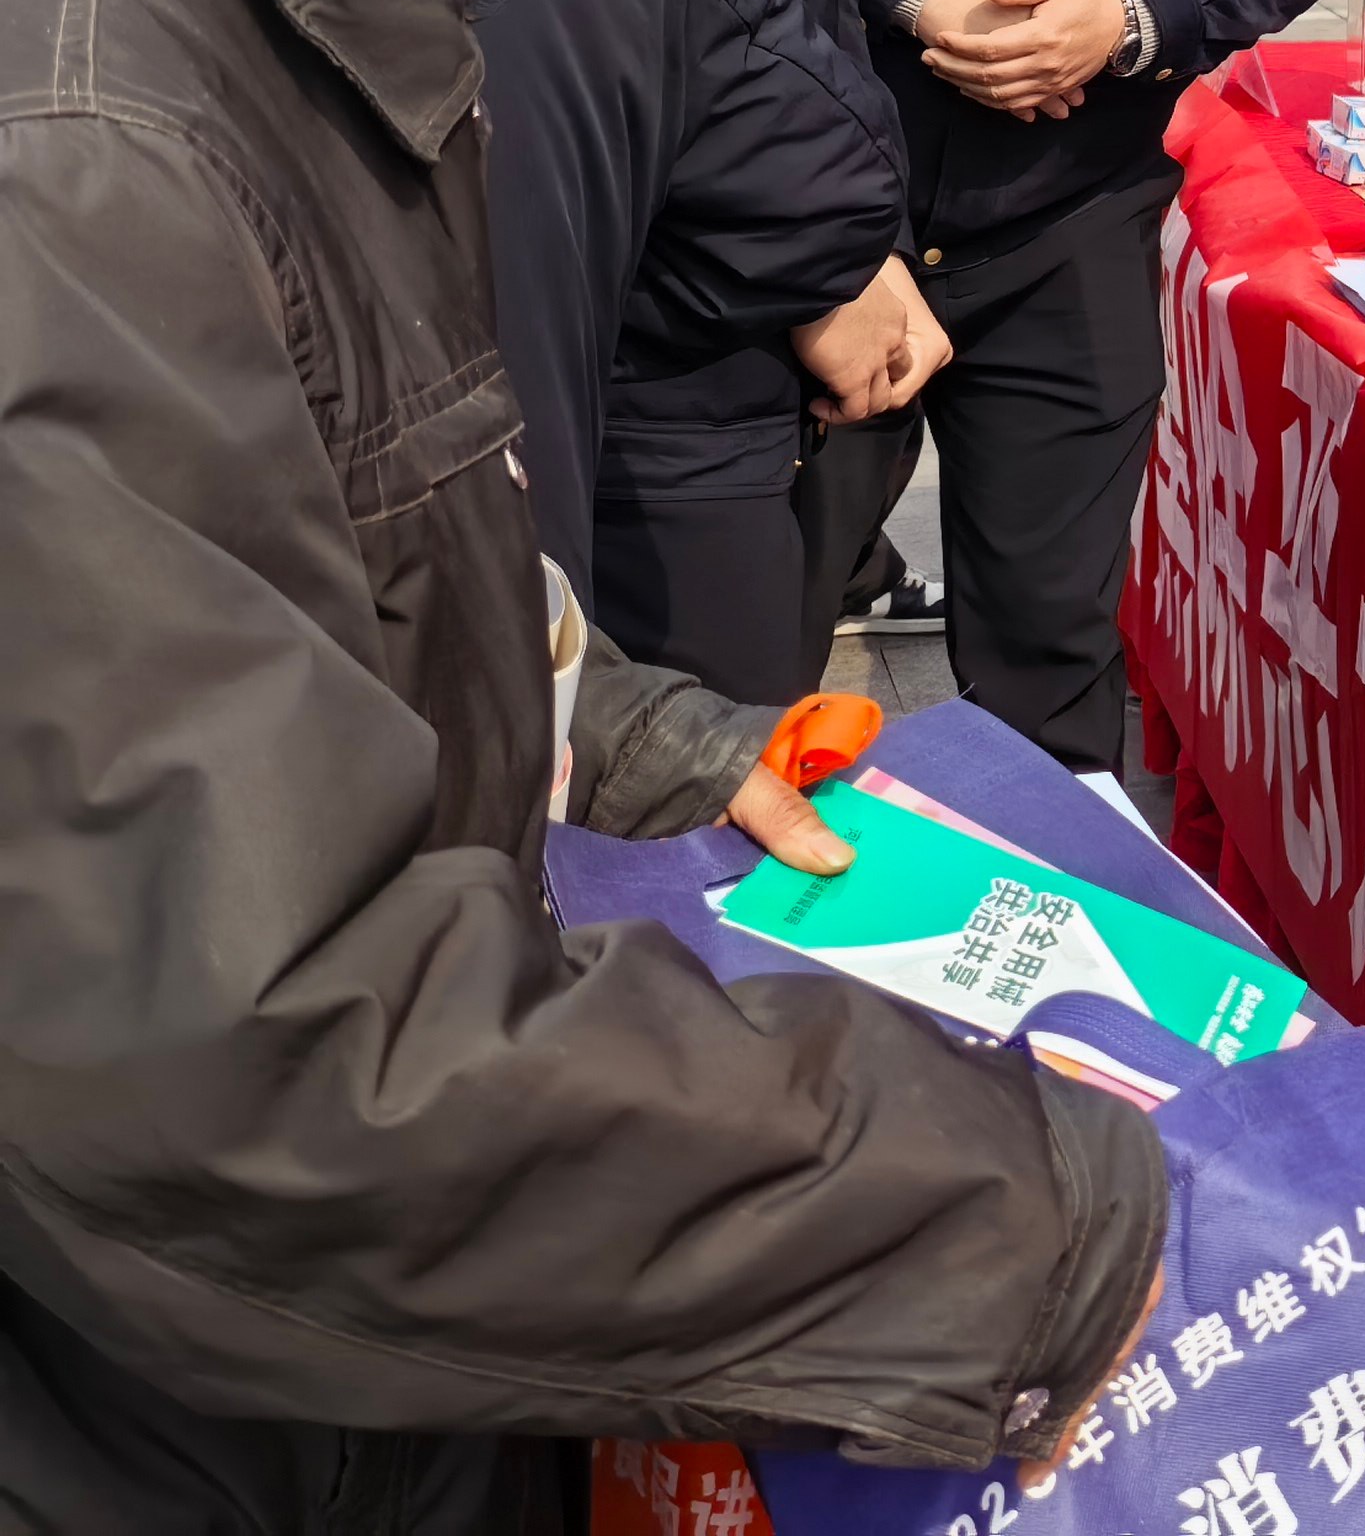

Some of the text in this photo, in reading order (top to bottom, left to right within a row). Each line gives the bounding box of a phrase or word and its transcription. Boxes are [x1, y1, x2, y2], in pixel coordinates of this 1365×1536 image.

[941, 877, 1034, 993] 共治共享
[993, 891, 1075, 1007] 安全用械
